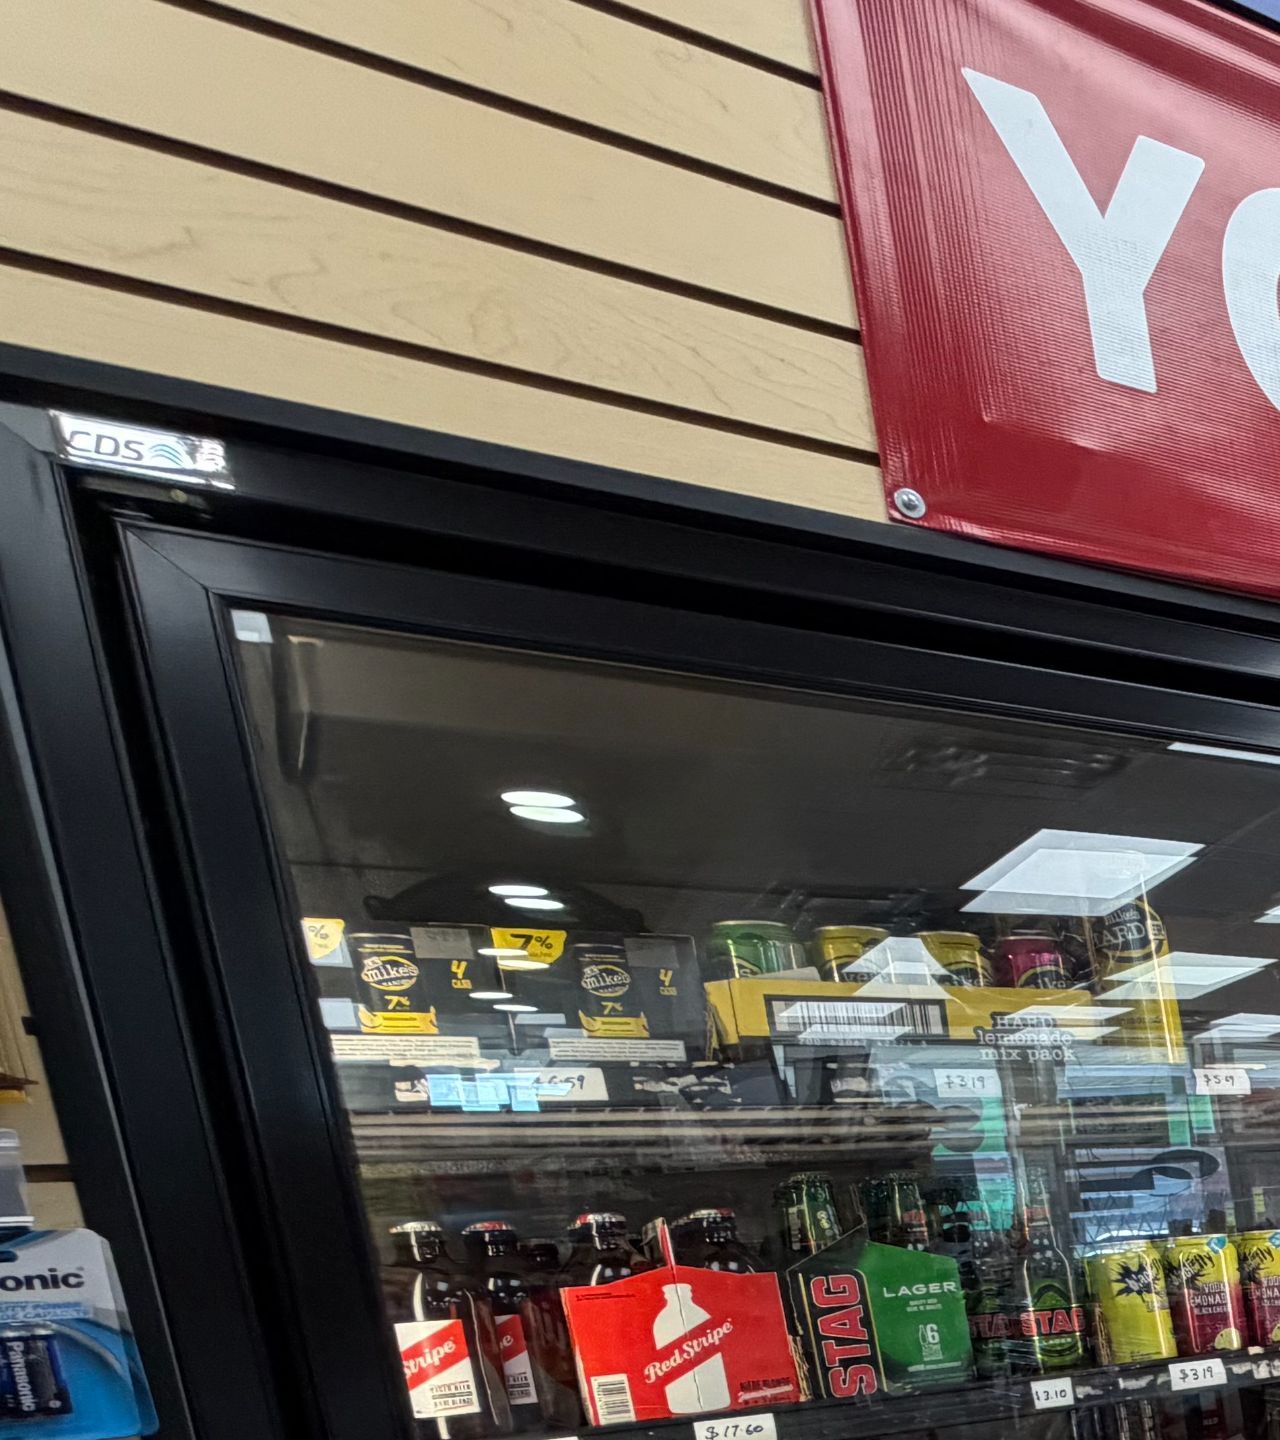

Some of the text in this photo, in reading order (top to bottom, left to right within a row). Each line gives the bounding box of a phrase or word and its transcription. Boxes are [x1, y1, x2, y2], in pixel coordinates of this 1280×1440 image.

[66, 430, 145, 461] CDS
[510, 933, 555, 951] 7%
[365, 961, 419, 981] mike's
[993, 1014, 1056, 1030] HARD
[978, 1028, 1074, 1046] lemonade
[979, 1046, 1077, 1064] mix pack
[882, 1280, 959, 1299] LAGER
[1021, 1307, 1085, 1337] STAG
[809, 1273, 879, 1401] STAG
[645, 1318, 734, 1385] Red Stripe
[6, 1341, 36, 1413] Panasonic
